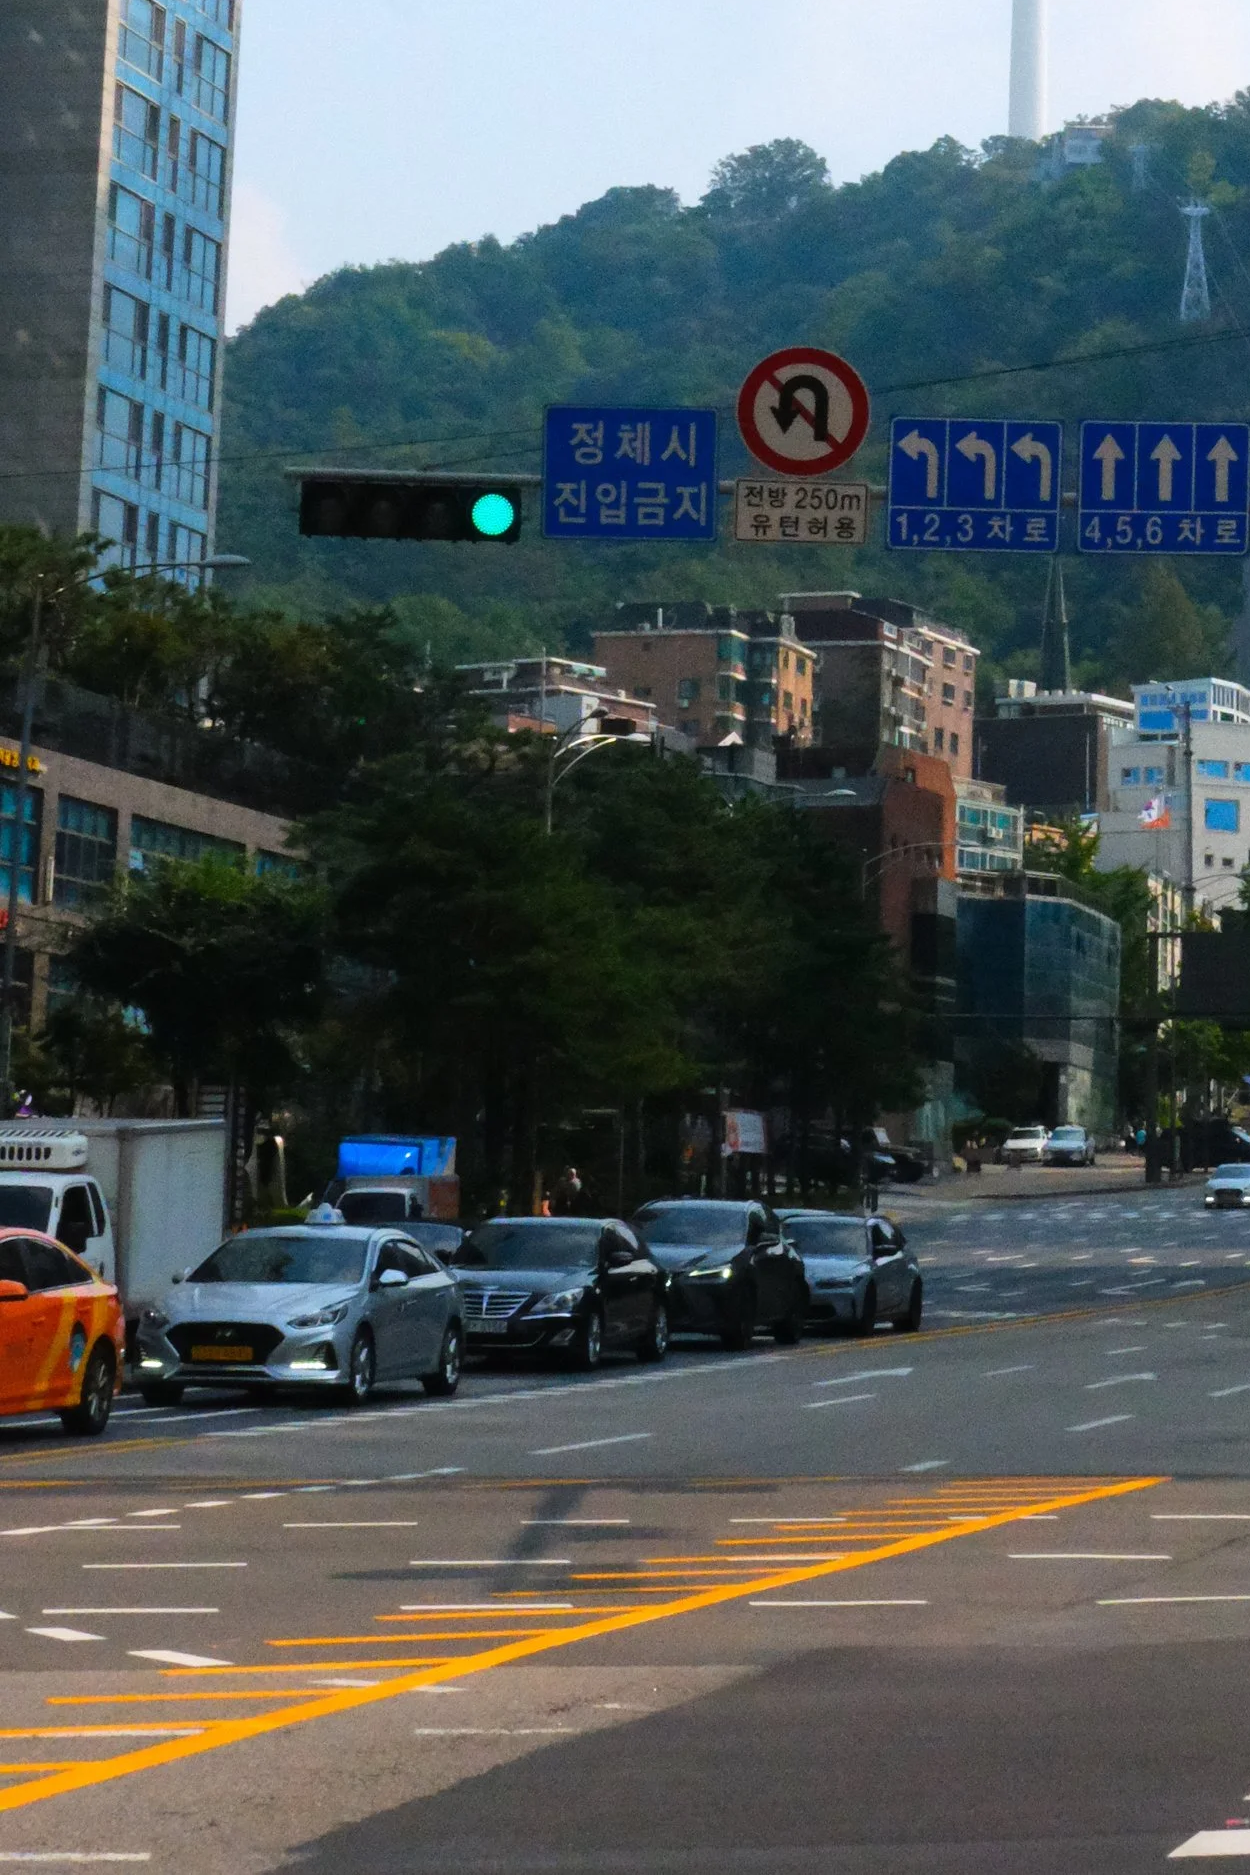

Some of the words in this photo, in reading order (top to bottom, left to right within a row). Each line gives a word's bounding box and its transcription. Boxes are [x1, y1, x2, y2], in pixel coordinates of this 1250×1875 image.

[568, 420, 697, 467] 정체시
[553, 479, 707, 527] 진입금지
[744, 485, 788, 509] 전방
[795, 487, 861, 510] 250m
[751, 514, 856, 538] 유턴허용
[896, 513, 974, 546] 1,2,3
[987, 514, 1049, 543] 차로
[1085, 516, 1163, 549] 4,5,6
[1177, 516, 1241, 546] 차로
